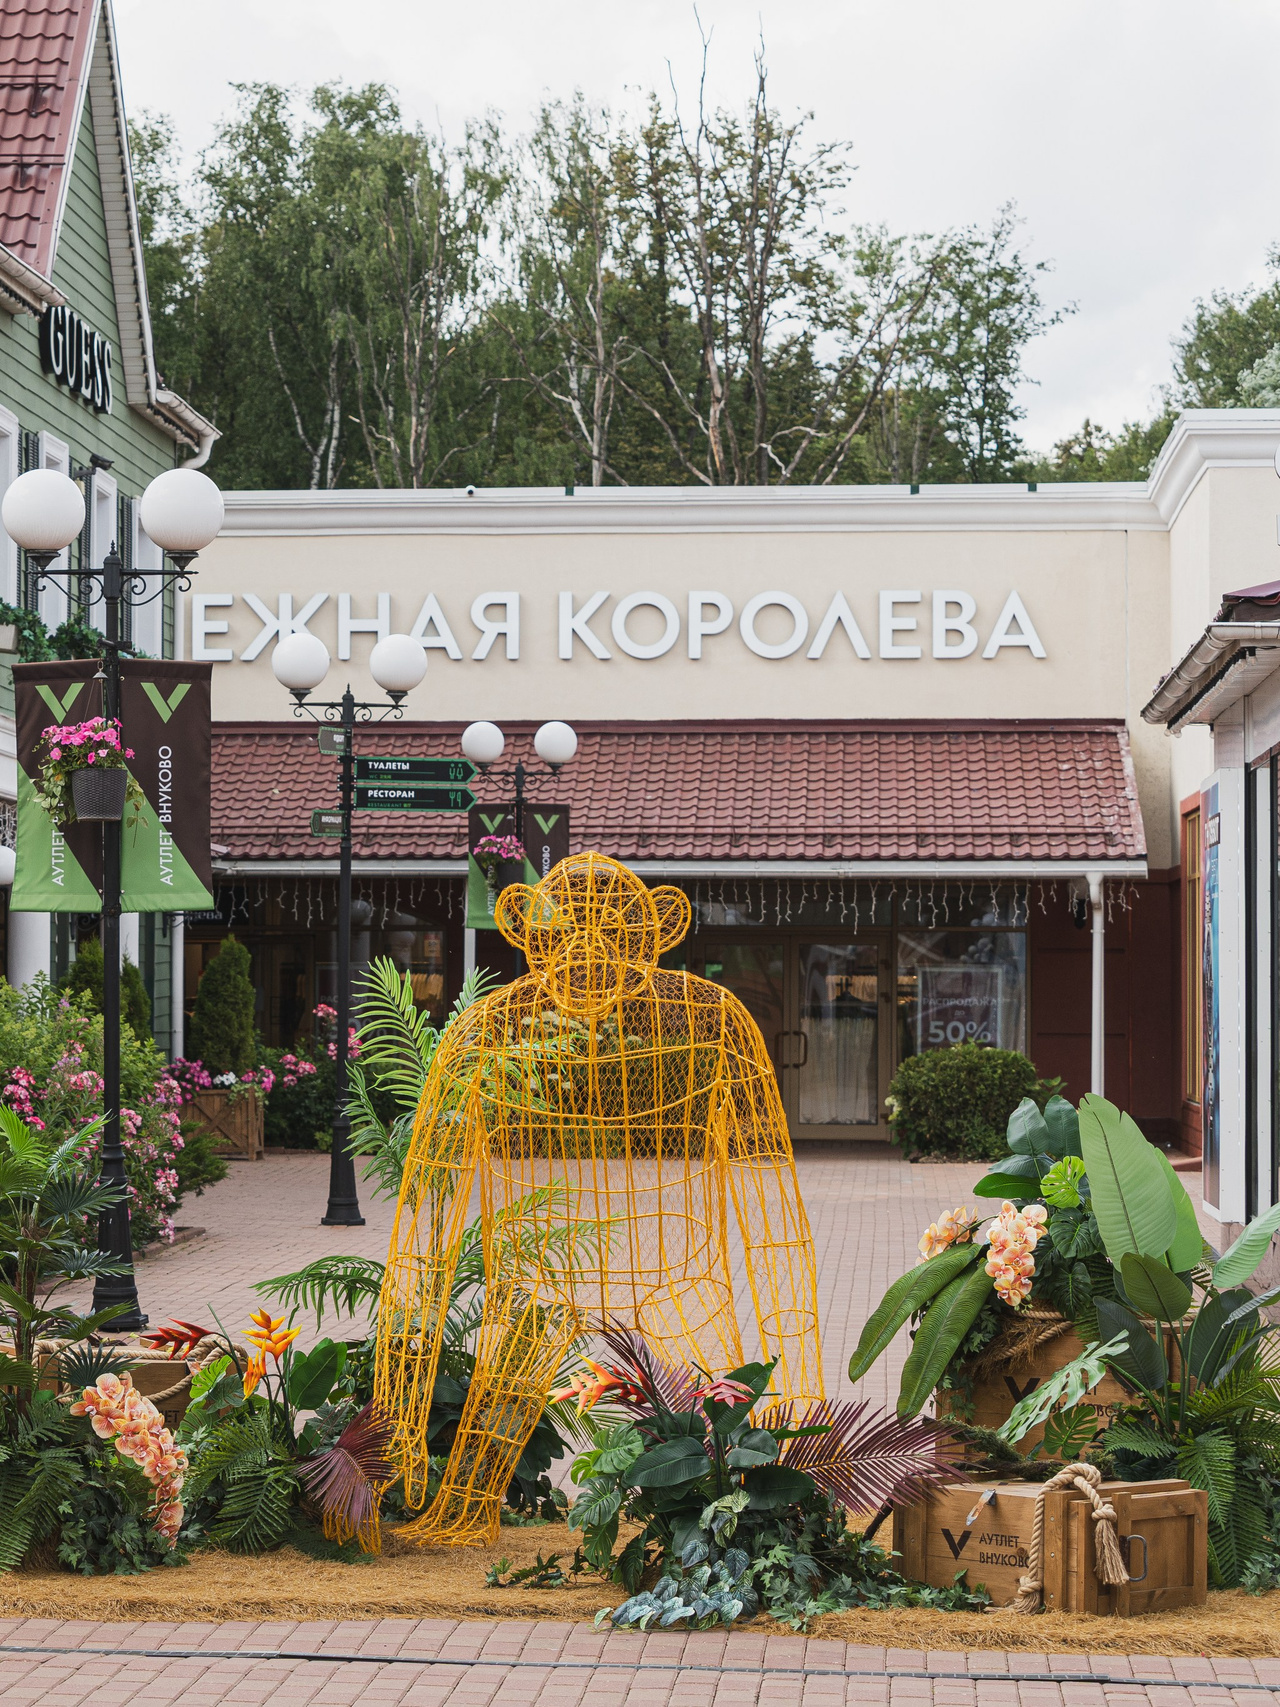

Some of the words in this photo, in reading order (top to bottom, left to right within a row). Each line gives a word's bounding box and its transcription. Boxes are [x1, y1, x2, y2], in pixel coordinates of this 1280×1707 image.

[38, 305, 113, 415] GUESS
[559, 590, 1047, 661] КОРОЛЕВА
[158, 745, 173, 823] ВНУКОВО
[368, 761, 410, 770] ТУАЛЕТЫ
[368, 790, 415, 798] РЕСТОРАН
[51, 829, 65, 886] АУТЛЕТ
[158, 829, 173, 886] АУТЛЕТ
[928, 1021, 991, 1043] 50%
[979, 1533, 1019, 1549] АУТЛЕТ
